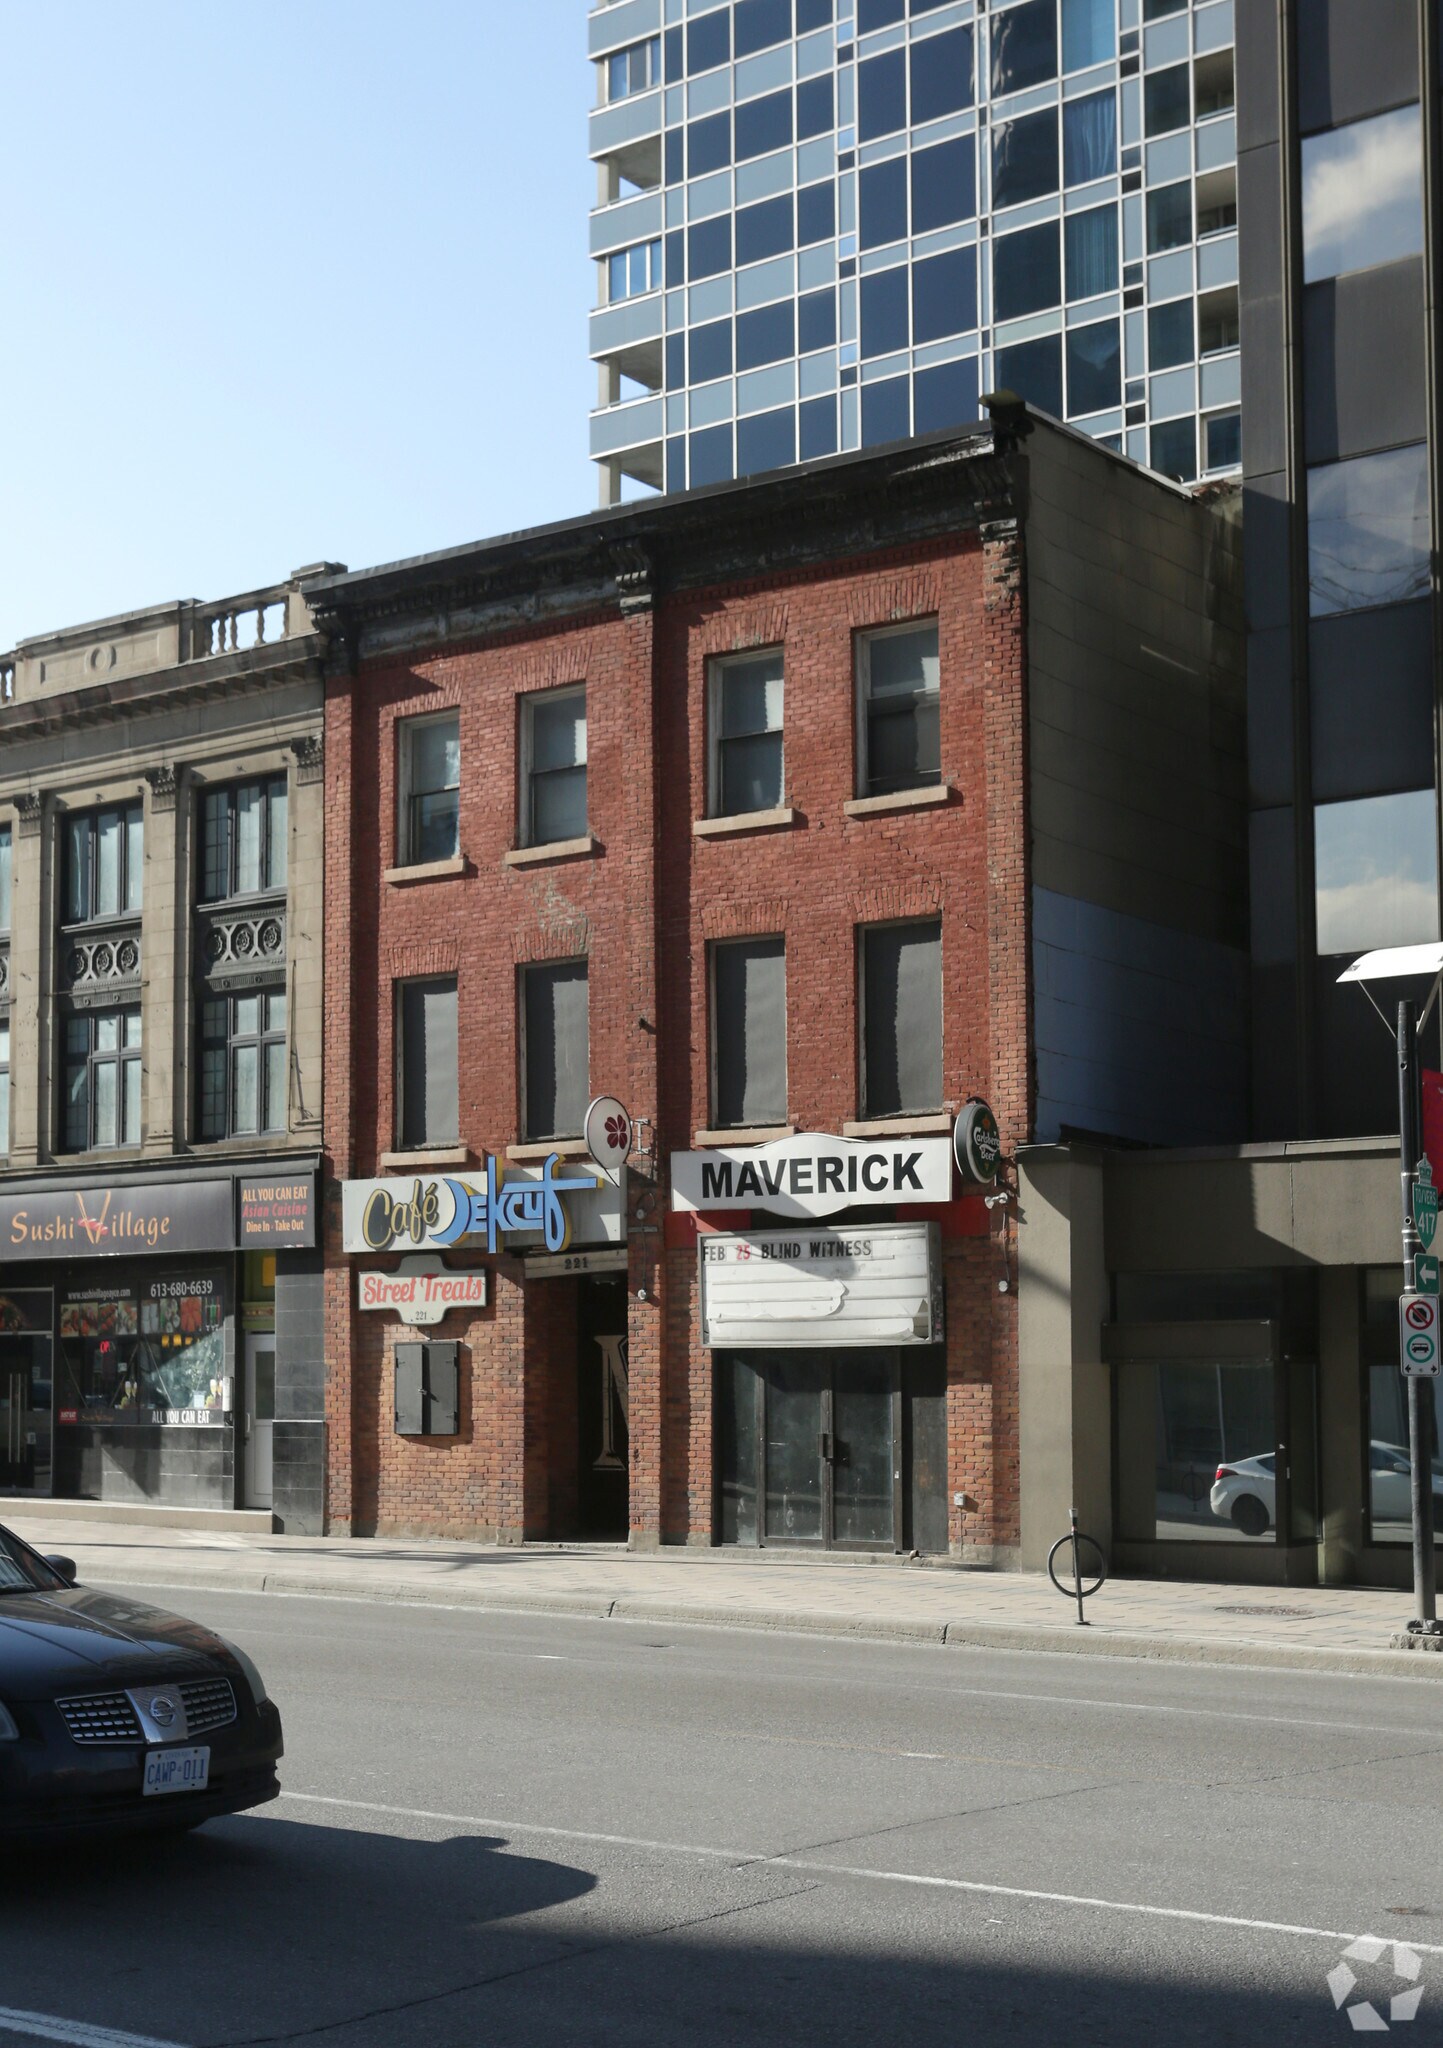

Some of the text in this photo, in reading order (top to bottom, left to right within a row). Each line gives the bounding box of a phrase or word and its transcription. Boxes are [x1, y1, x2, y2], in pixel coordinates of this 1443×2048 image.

[980, 1148, 995, 1161] Beer
[702, 1152, 924, 1199] MAVERICK
[243, 1185, 308, 1202] ALL YOU CAN EAT
[242, 1203, 308, 1217] Asian Cuisine
[363, 1179, 438, 1249] Café
[11, 1211, 74, 1243] Sushi
[246, 1219, 304, 1232] Dine In Take Out
[1418, 1211, 1435, 1235] 417
[703, 1246, 725, 1261] FEB
[736, 1245, 751, 1260] 25
[564, 1257, 589, 1270] 221
[151, 1280, 213, 1297] 613-680-6639
[364, 1273, 483, 1304] Street Treats
[415, 1311, 427, 1321] 221
[152, 1410, 210, 1424] ALL YOU CAN EAT
